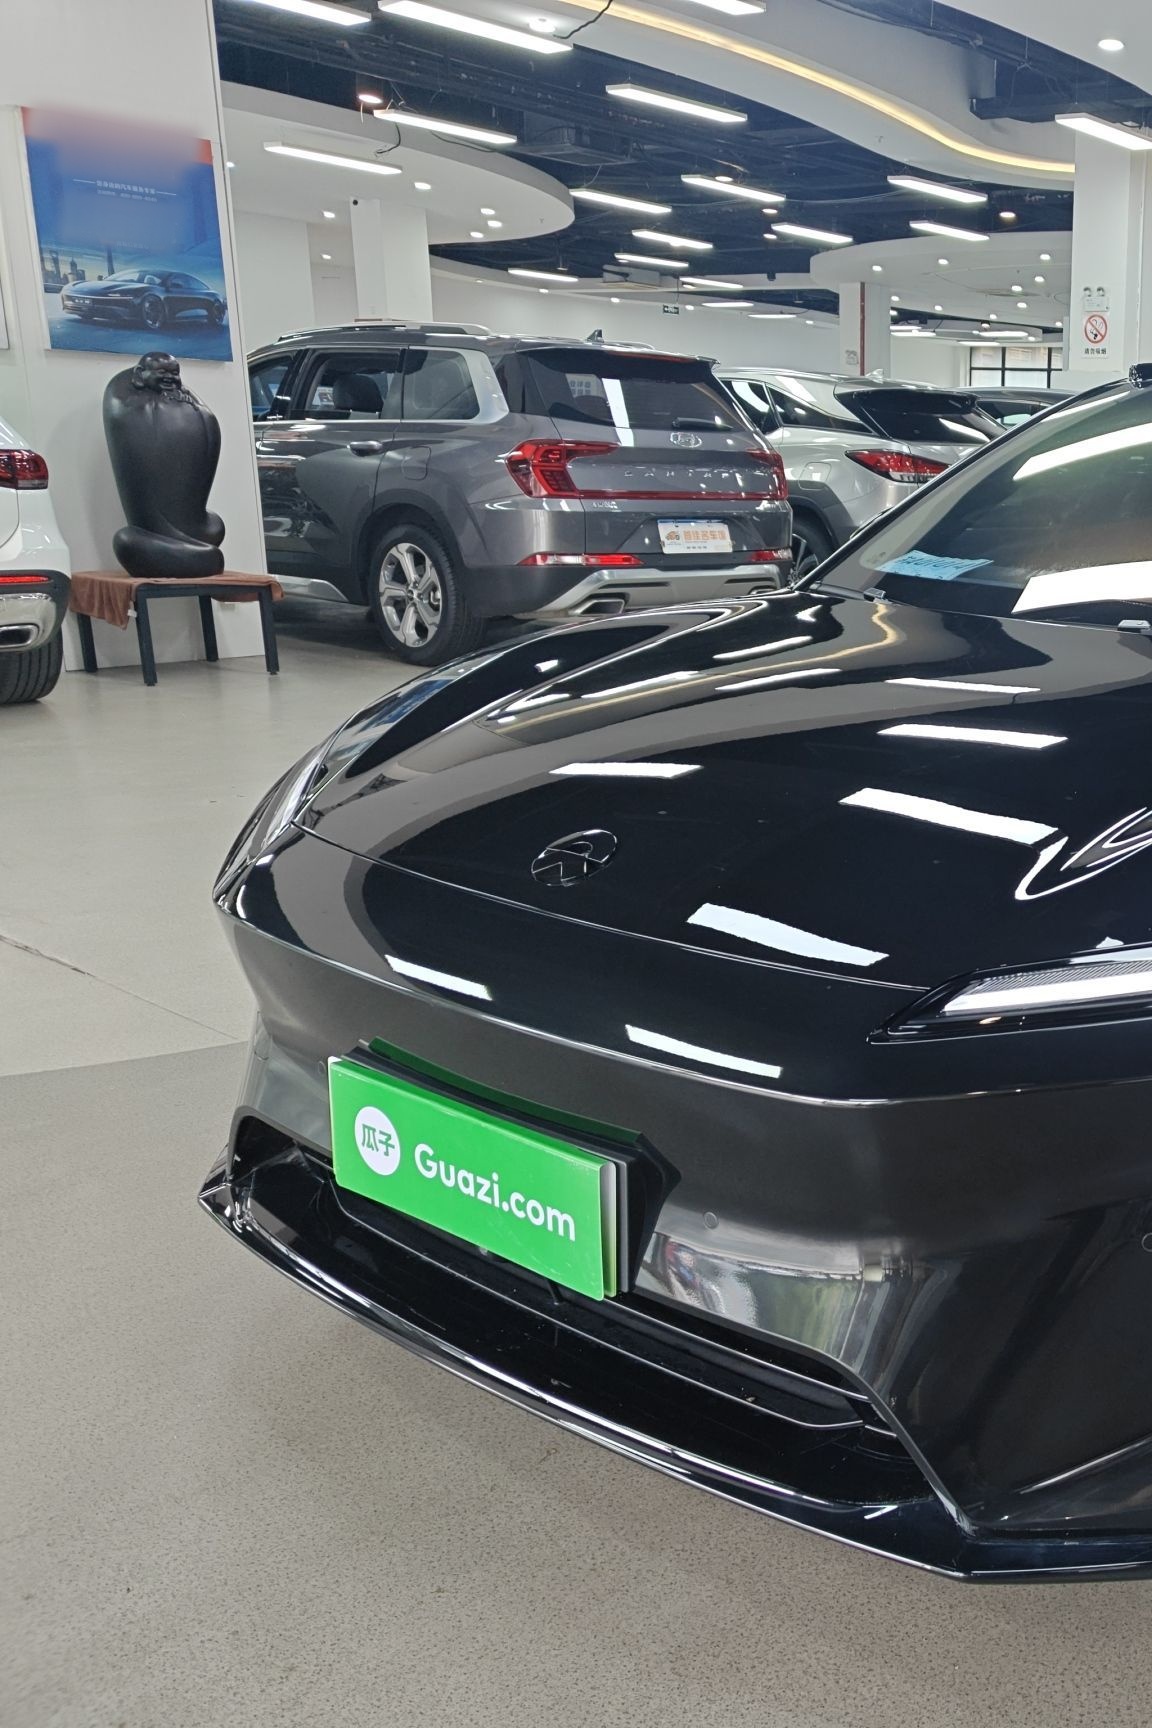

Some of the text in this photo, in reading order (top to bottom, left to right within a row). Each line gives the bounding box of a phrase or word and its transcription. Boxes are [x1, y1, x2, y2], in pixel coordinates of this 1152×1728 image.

[1084, 347, 1107, 355] 请勿吸烟
[361, 1123, 396, 1156] 瓜子
[414, 1143, 576, 1242] Guazi.com
